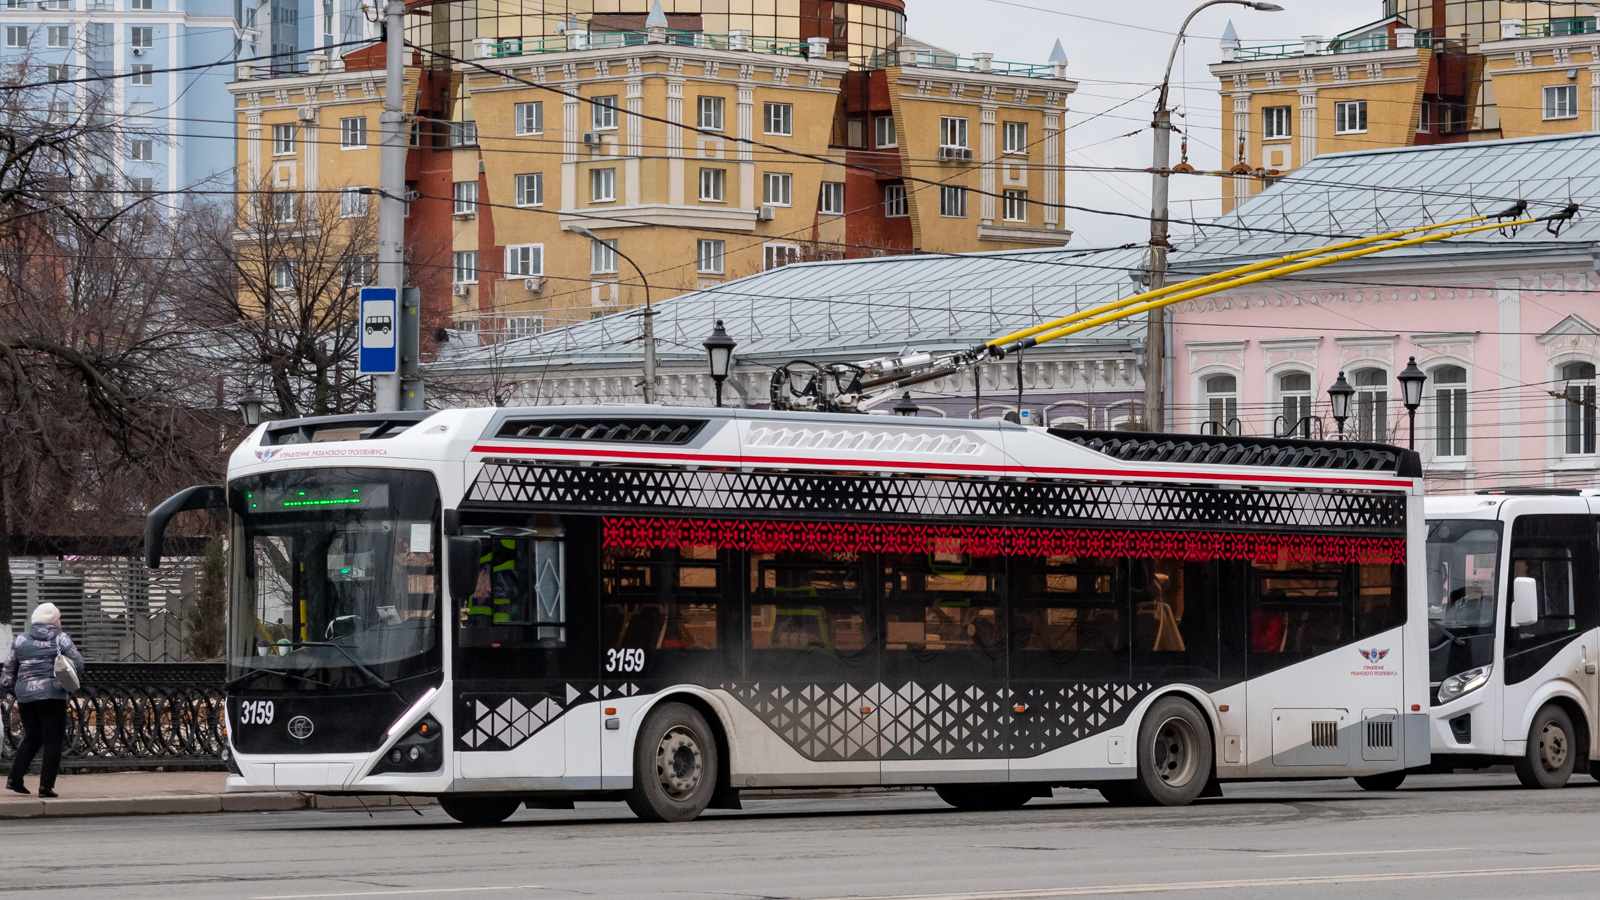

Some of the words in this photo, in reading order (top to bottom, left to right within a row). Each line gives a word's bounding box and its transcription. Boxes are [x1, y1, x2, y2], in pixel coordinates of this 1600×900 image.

[280, 450, 310, 458] УПРАВЛЕНИЕ
[312, 449, 346, 457] РЯЗАНСКОГО
[348, 448, 387, 456] ТРОЛЛЕЙБУСА
[606, 648, 645, 672] 3159
[241, 700, 274, 725] 3159
